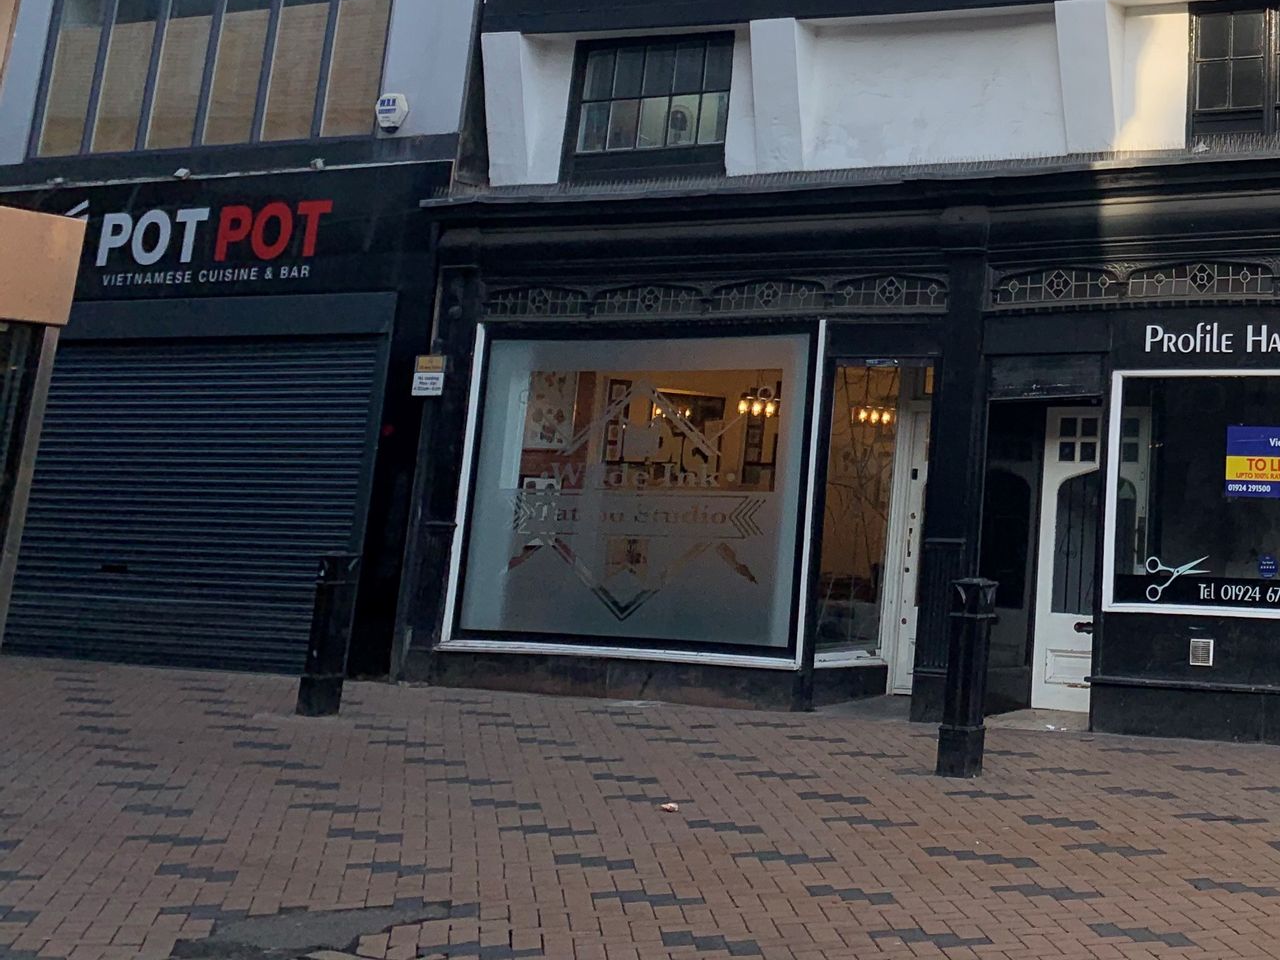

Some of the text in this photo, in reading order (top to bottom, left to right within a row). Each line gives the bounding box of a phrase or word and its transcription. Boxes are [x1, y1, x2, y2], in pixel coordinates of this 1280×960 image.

[96, 200, 333, 266] POT POT
[102, 266, 310, 286] VIETNAMESE CUISINE & BAR
[1246, 458, 1267, 471] TO
[1228, 484, 1247, 492] 01924
[1248, 484, 1271, 492] 291500
[1198, 583, 1215, 599] Tel
[1220, 584, 1261, 601] 01924
